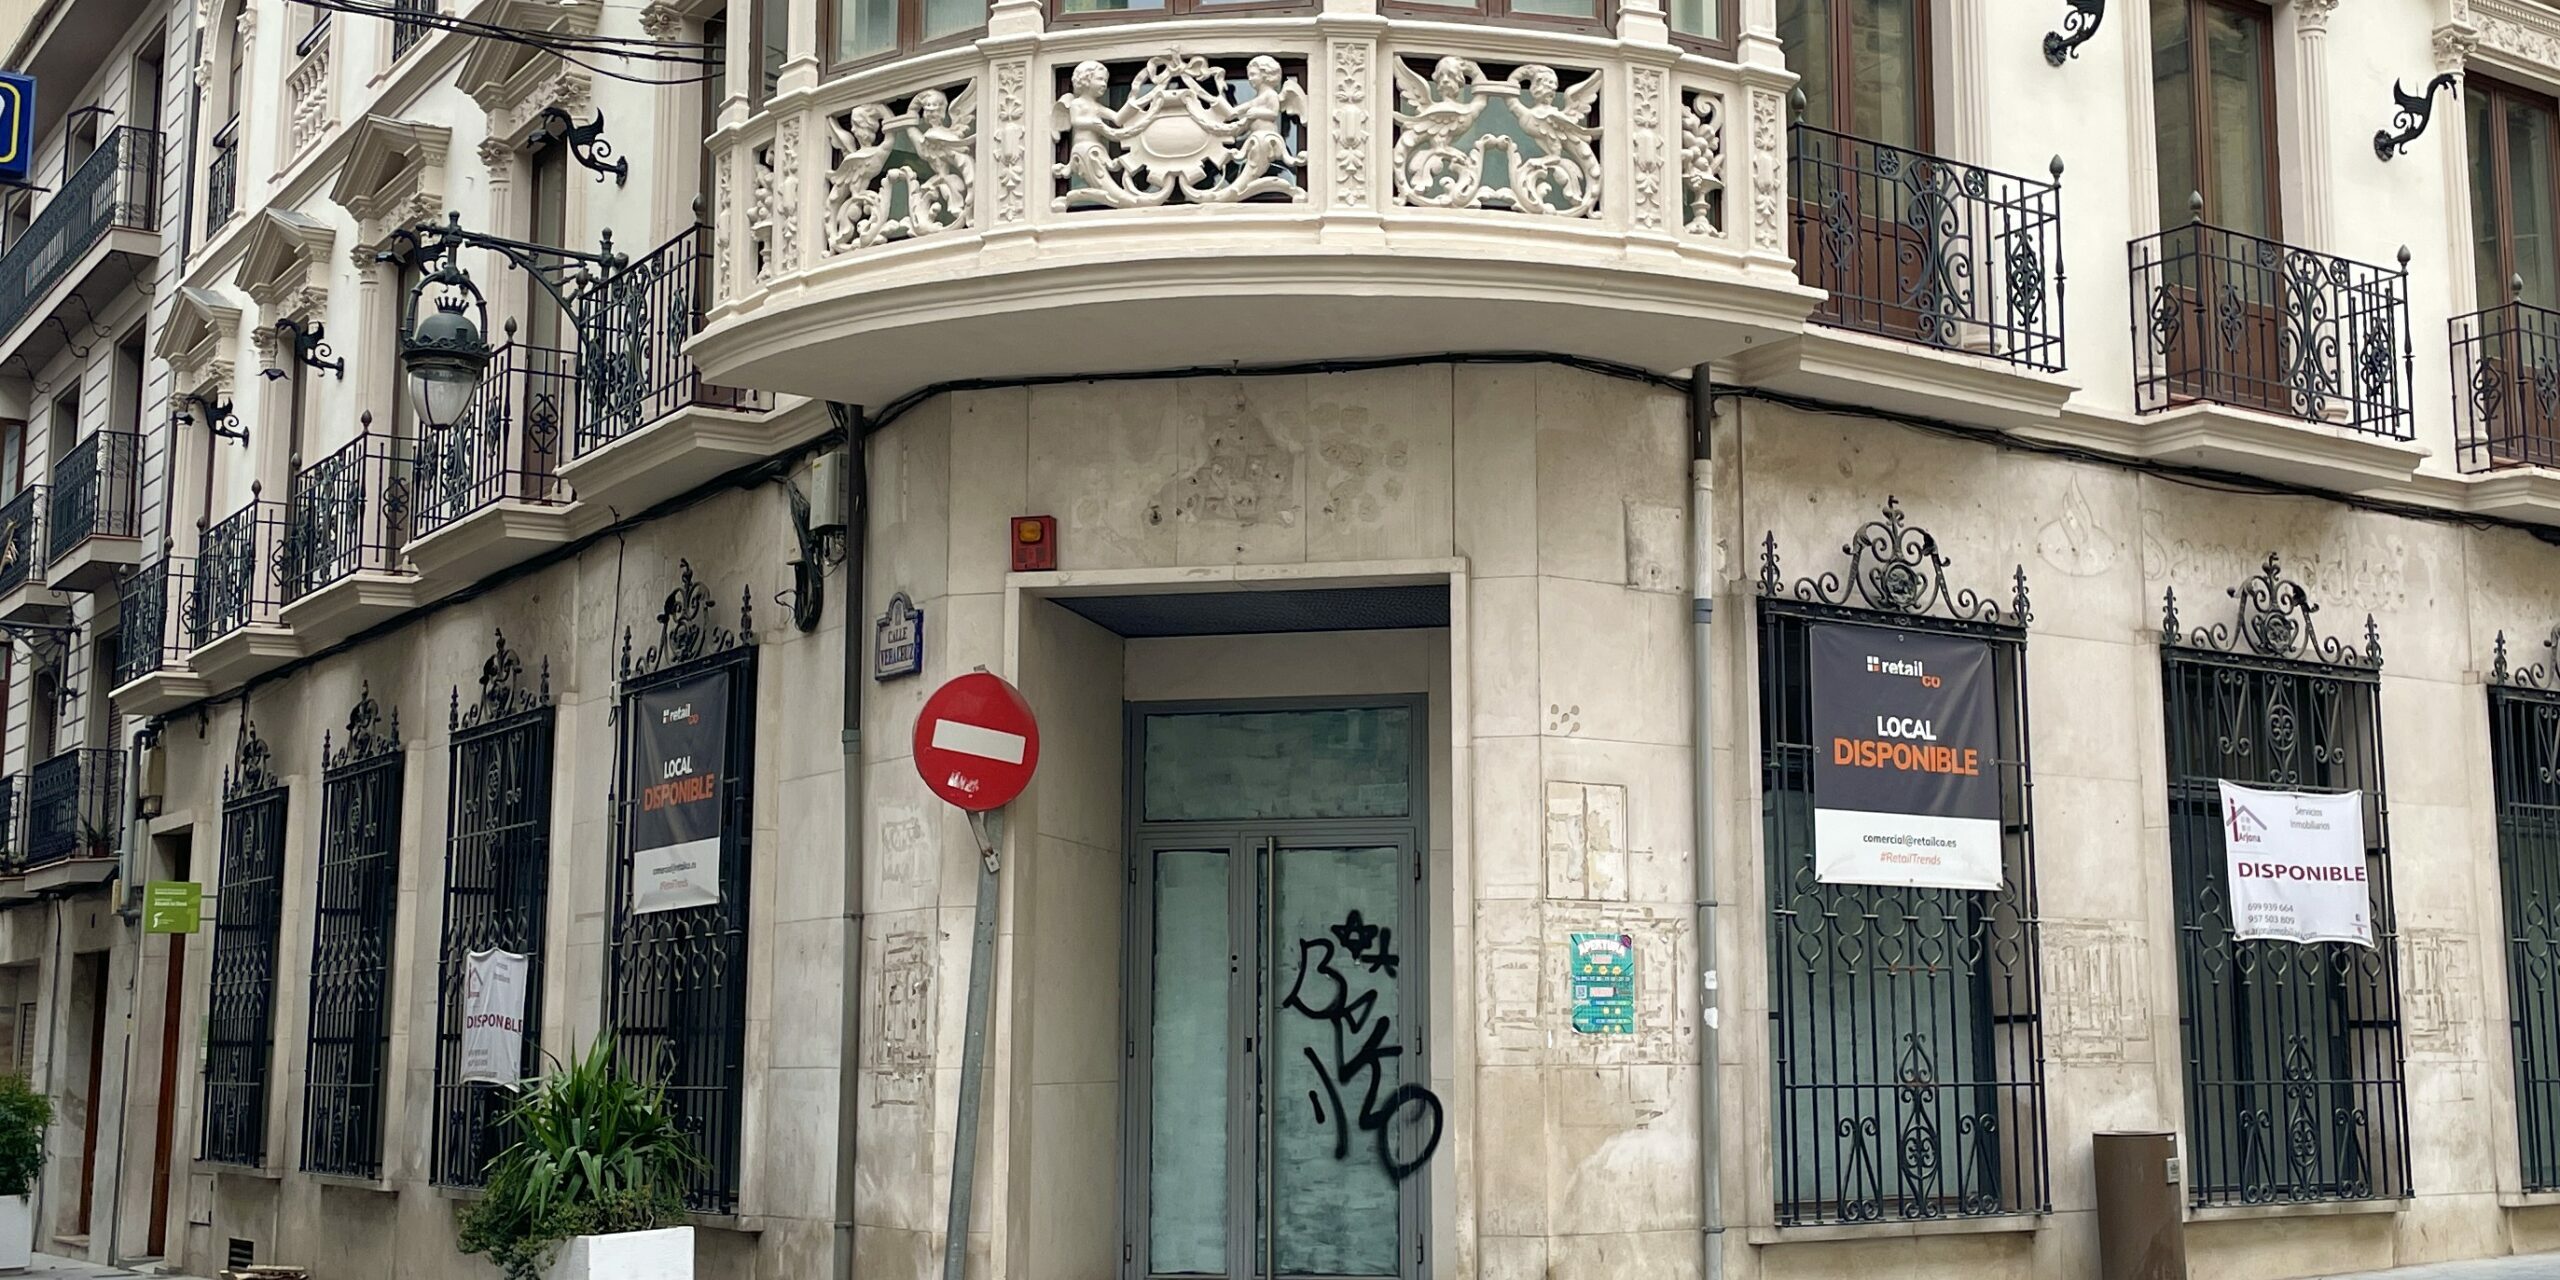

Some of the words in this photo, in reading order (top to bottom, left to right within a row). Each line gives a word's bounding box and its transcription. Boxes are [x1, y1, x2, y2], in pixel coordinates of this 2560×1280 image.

[887, 626, 908, 644] CALLE
[1881, 659, 1923, 677] retail
[669, 703, 691, 722] retail
[1877, 715, 1937, 741] LOCAL
[663, 755, 693, 779] LOCAL
[1833, 738, 1980, 777] DISPONIBLE
[643, 773, 716, 812] DISPONIBLE
[1879, 851, 1942, 866] #RetailTrends
[2238, 862, 2367, 882] DISPONIBLE
[2248, 903, 2262, 912] 699
[2264, 903, 2279, 912] 939
[2248, 915, 2263, 924] 957
